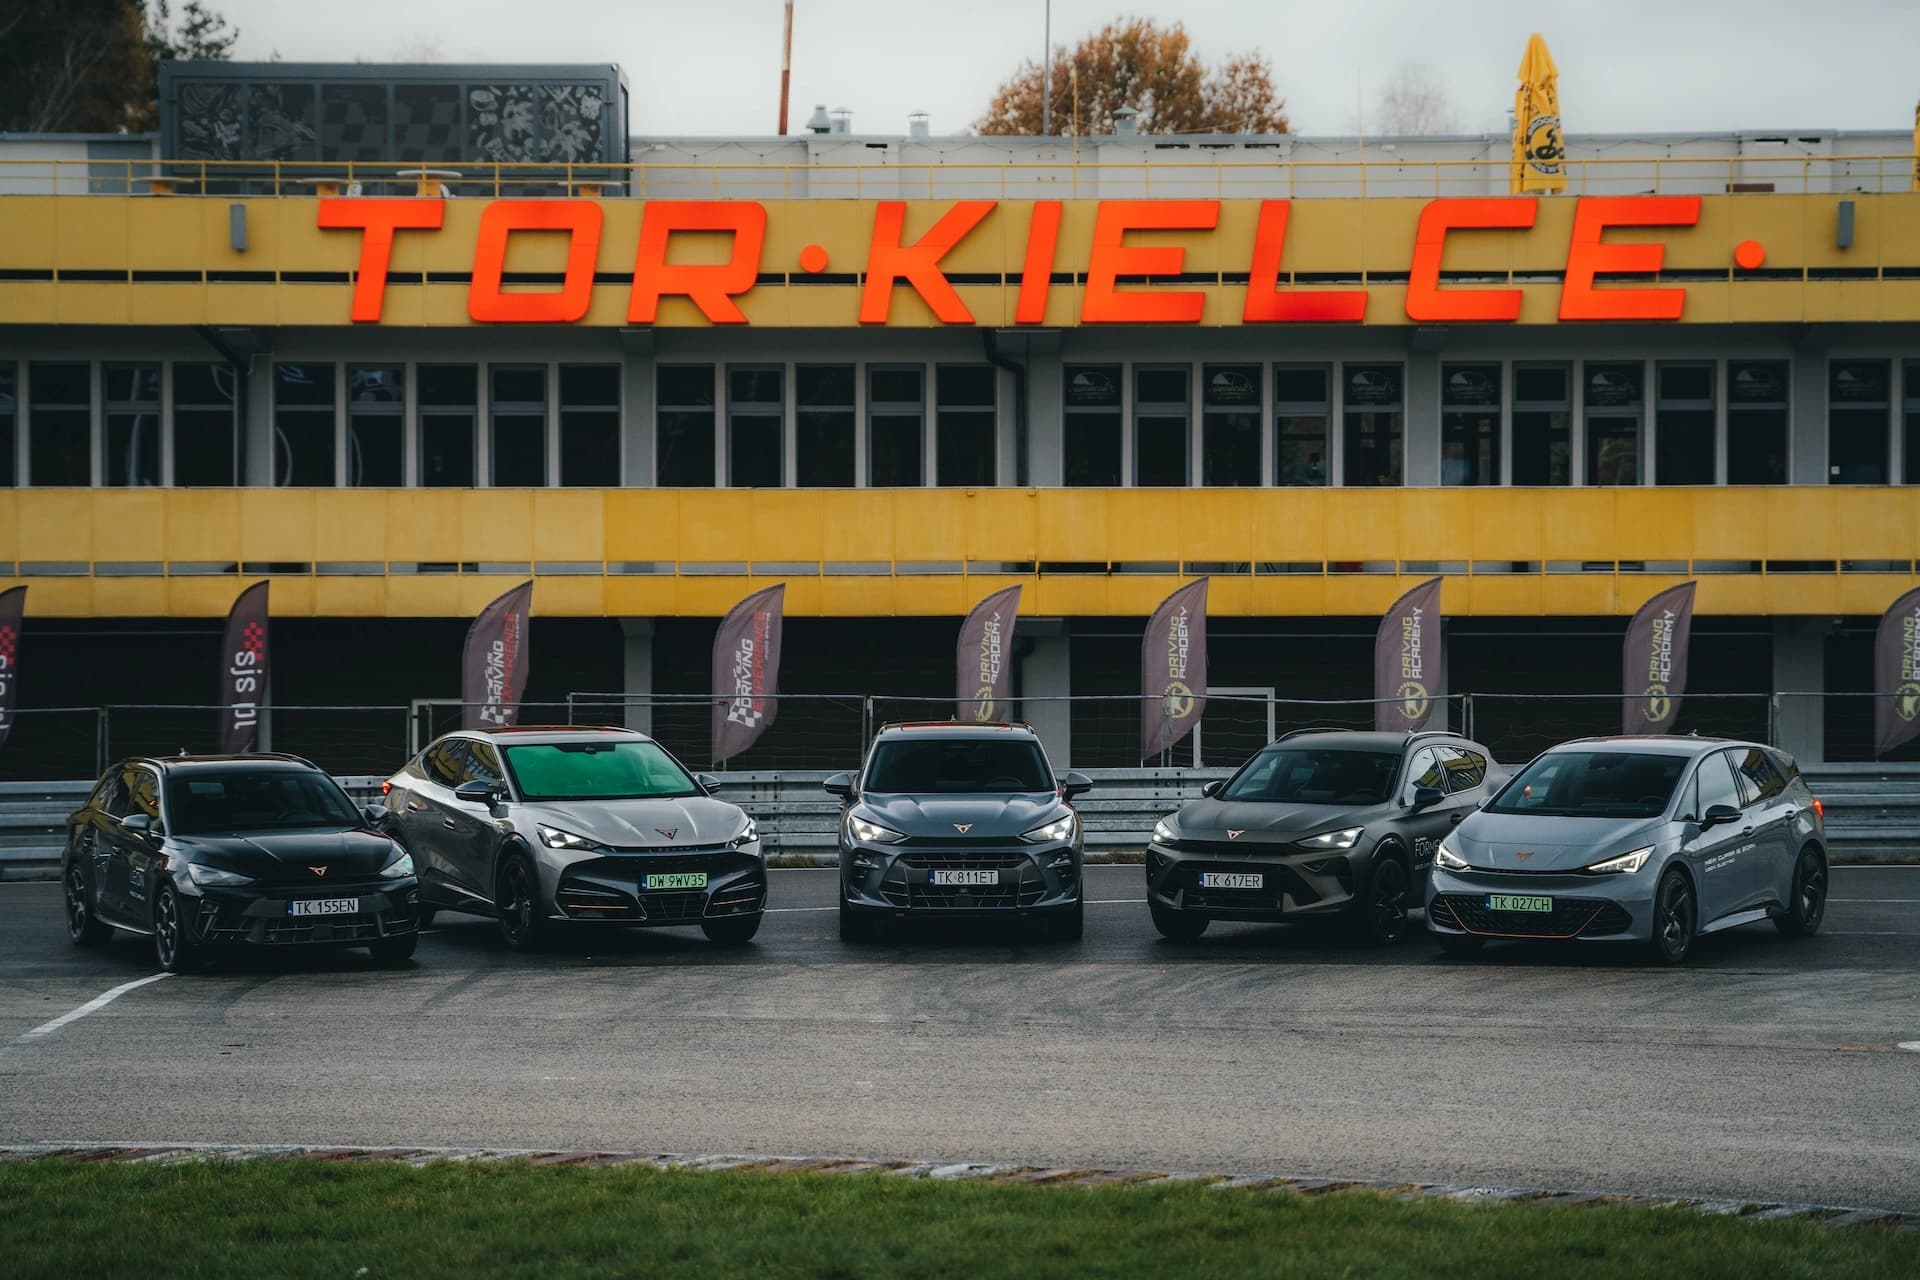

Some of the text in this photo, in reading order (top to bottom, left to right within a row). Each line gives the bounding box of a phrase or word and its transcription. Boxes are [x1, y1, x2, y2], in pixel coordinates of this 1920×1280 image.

[315, 196, 1702, 323] TOR KIELCE
[740, 638, 754, 707] DRIVING
[753, 610, 766, 712] EXPERIENCE
[980, 621, 992, 683] DRIVING
[990, 612, 1001, 684] ACADEMY
[1169, 616, 1179, 678] DRIVING
[1178, 606, 1188, 679] ACADEMY
[1401, 616, 1413, 678] DRIVING
[1412, 607, 1423, 679] ACADEMY
[1649, 618, 1664, 681] DRIVING
[1660, 609, 1675, 683] ACADEMY
[1902, 616, 1914, 680] DRIVING
[295, 898, 355, 915] TK 155EN
[649, 874, 704, 888] DW 9WV35
[937, 871, 995, 884] TK 811ET
[1205, 874, 1260, 888] TK 617ER
[1492, 896, 1550, 911] TK 027CH
